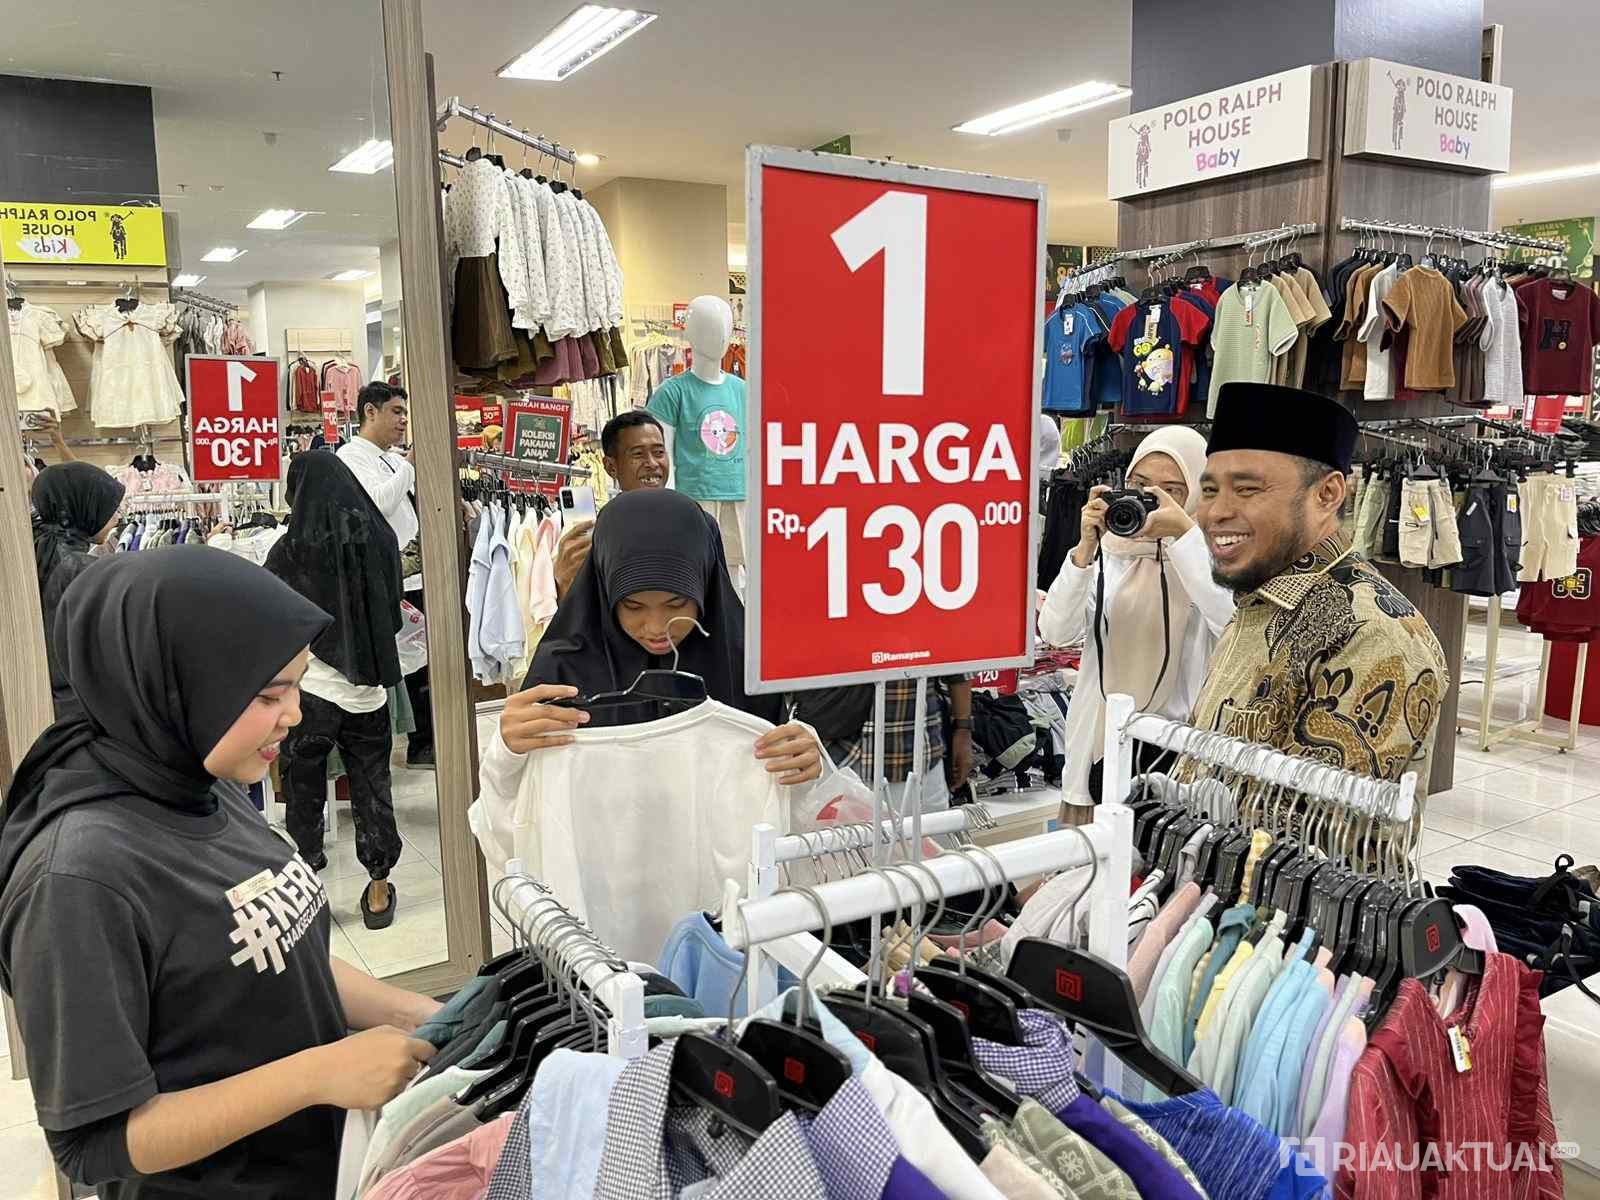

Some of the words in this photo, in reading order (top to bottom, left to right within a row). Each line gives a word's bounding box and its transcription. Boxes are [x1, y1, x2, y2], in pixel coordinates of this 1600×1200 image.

[1163, 102, 1212, 131] POLO
[1218, 82, 1283, 115] RALPH
[1416, 76, 1453, 101] POLO
[1456, 84, 1497, 111] RALPH
[1434, 105, 1478, 132] HOUSE
[1188, 116, 1251, 149] HOUSE
[1196, 148, 1240, 171] Baby
[1440, 133, 1471, 160] Baby
[830, 190, 928, 396] 1
[540, 403, 570, 413] BANGET
[519, 438, 556, 450] PAKAIAN
[521, 429, 556, 441] KOLEKSI
[522, 448, 549, 459] ANAK
[766, 421, 1022, 486] HARGA
[977, 670, 999, 684] 120
